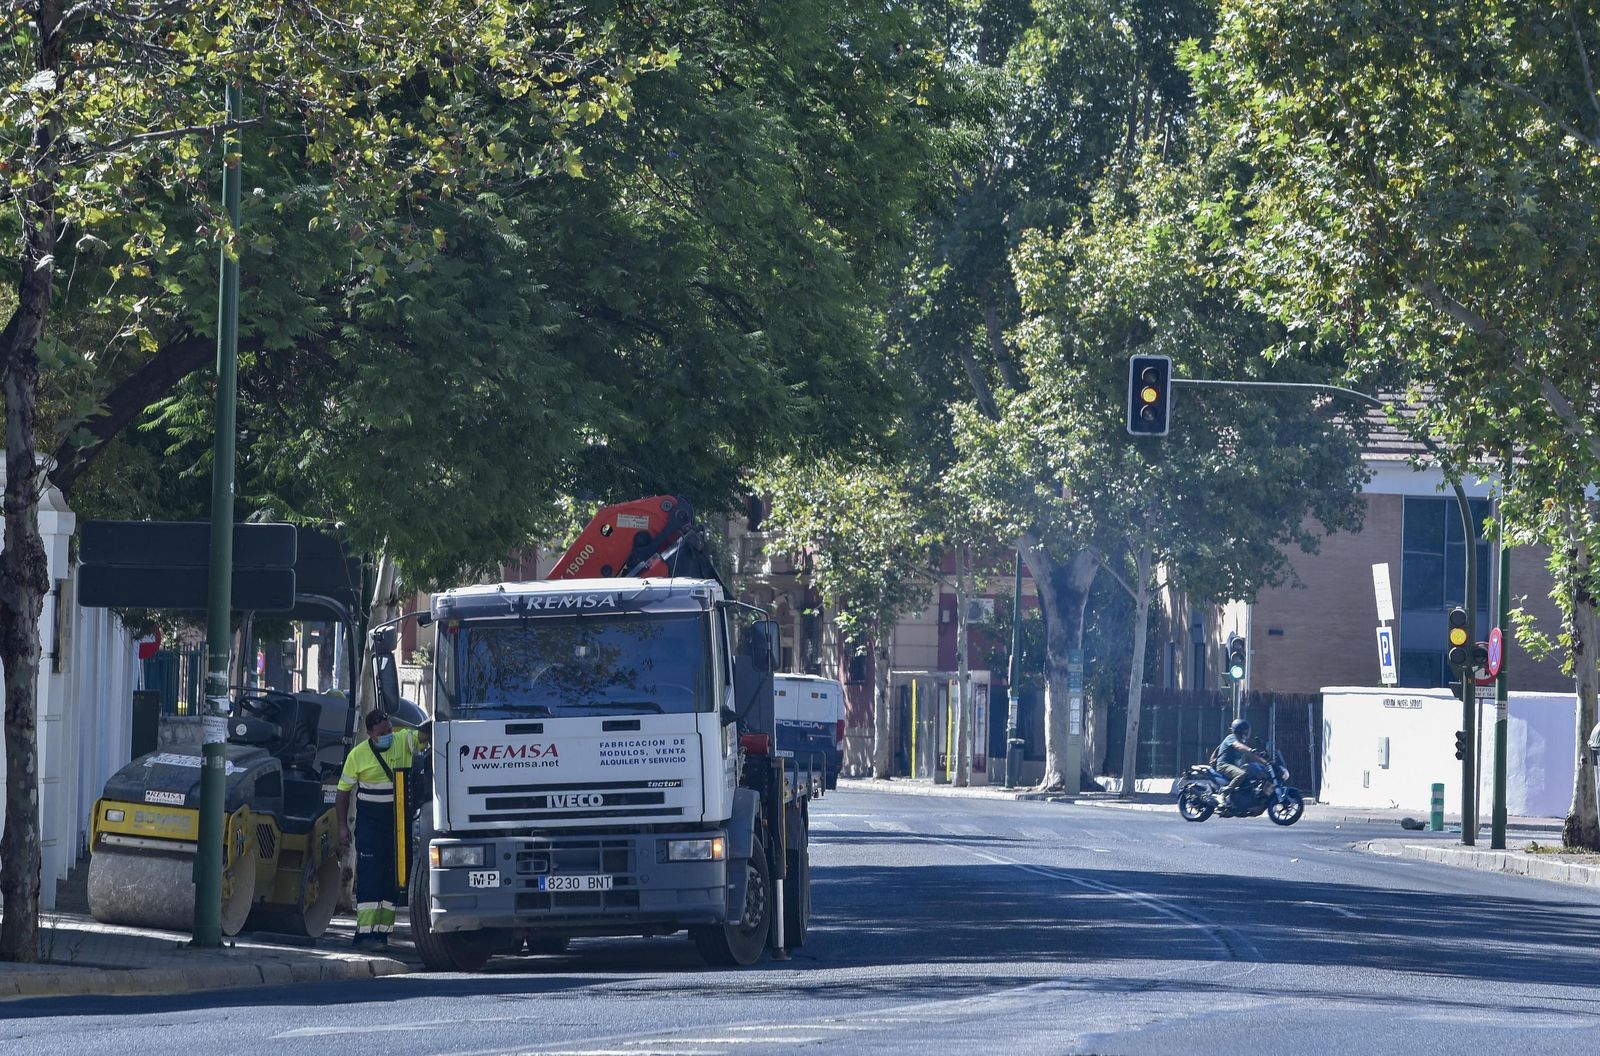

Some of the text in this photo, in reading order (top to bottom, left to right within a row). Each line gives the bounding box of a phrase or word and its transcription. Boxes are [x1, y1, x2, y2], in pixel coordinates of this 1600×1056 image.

[566, 544, 594, 576] 19000
[526, 594, 615, 610] REMSA
[600, 739, 666, 748] FABRICACION
[472, 743, 559, 760] REMSA
[600, 749, 649, 757] MODULOS,
[472, 760, 559, 769] www.remsa.net
[600, 758, 641, 766] ALQUILER
[648, 756, 686, 765] SERVICIO
[648, 780, 679, 788] tector
[150, 791, 183, 800] REMSA
[547, 793, 604, 808] IVECO
[548, 875, 612, 890] 8230 BNT
